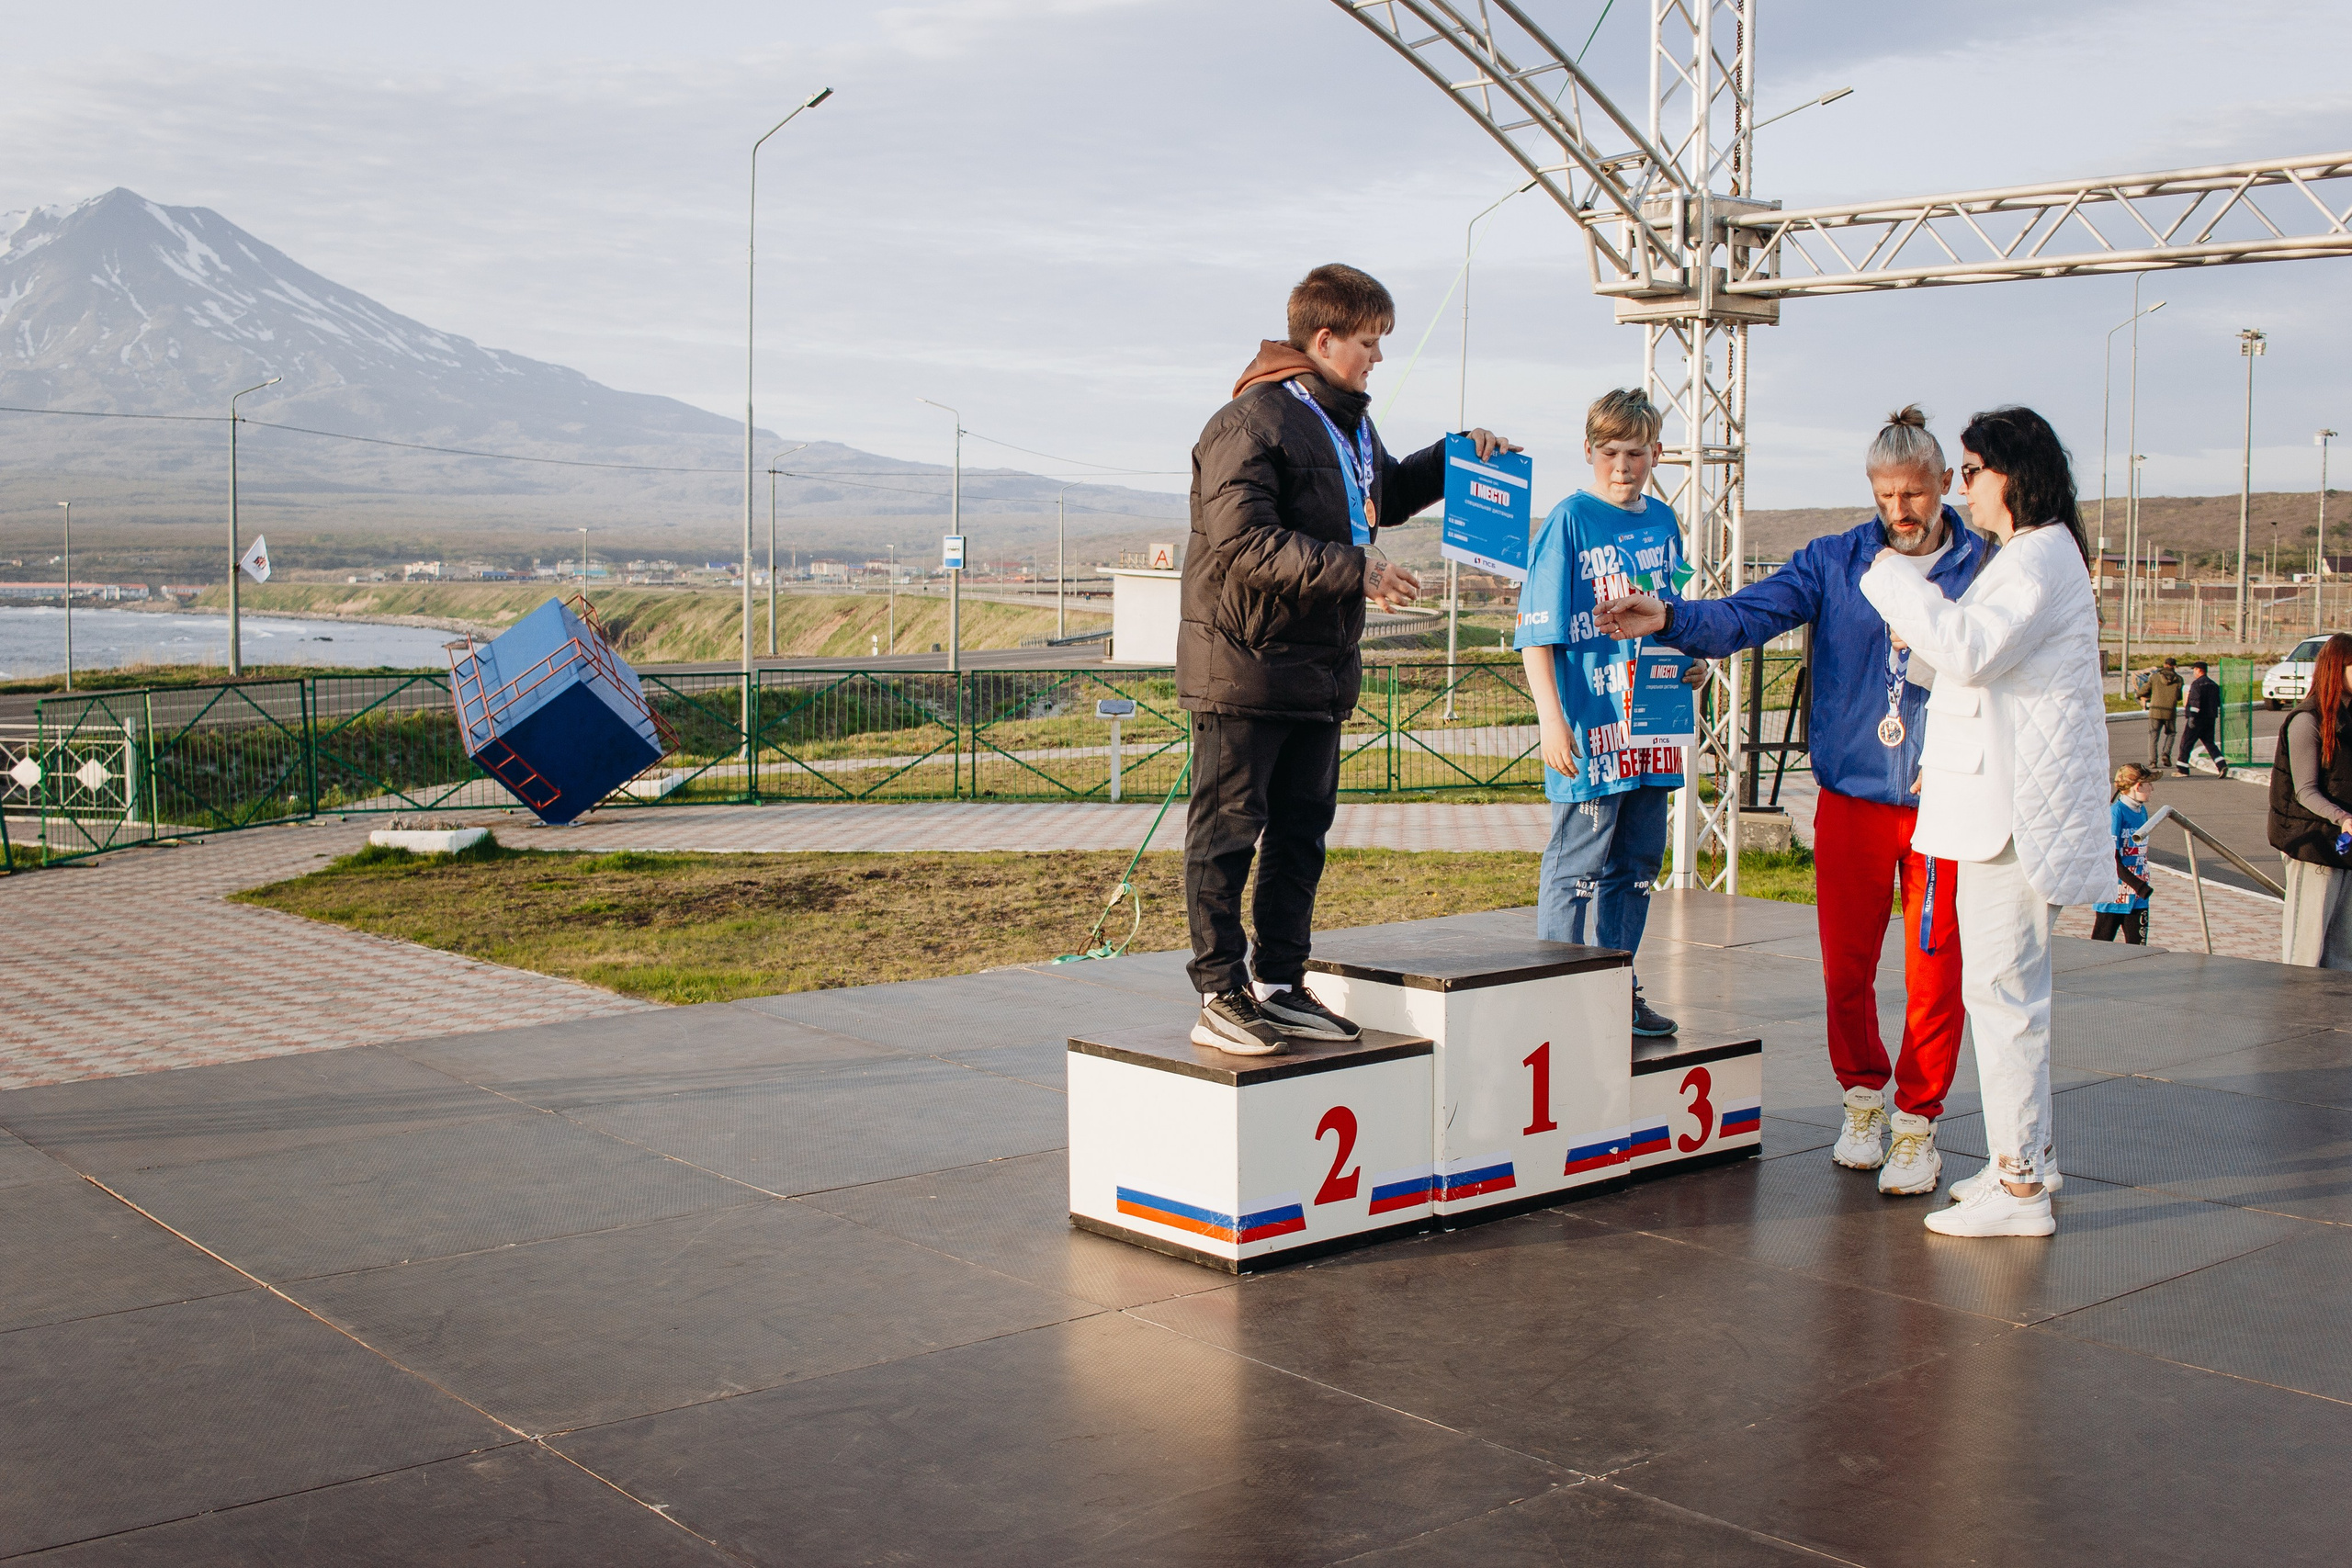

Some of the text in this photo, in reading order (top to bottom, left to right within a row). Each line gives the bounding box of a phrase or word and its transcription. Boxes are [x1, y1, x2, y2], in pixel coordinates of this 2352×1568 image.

[1477, 483, 1510, 507] МЕСТО
[1154, 549, 1170, 567] А
[1525, 610, 1549, 626] ПСБ
[1657, 665, 1679, 679] МЕСТО
[1925, 882, 1934, 912] ОБЛАСТЬ
[1521, 1041, 1557, 1136] 1
[1678, 1066, 1713, 1154] 3
[1314, 1105, 1362, 1206] 2
